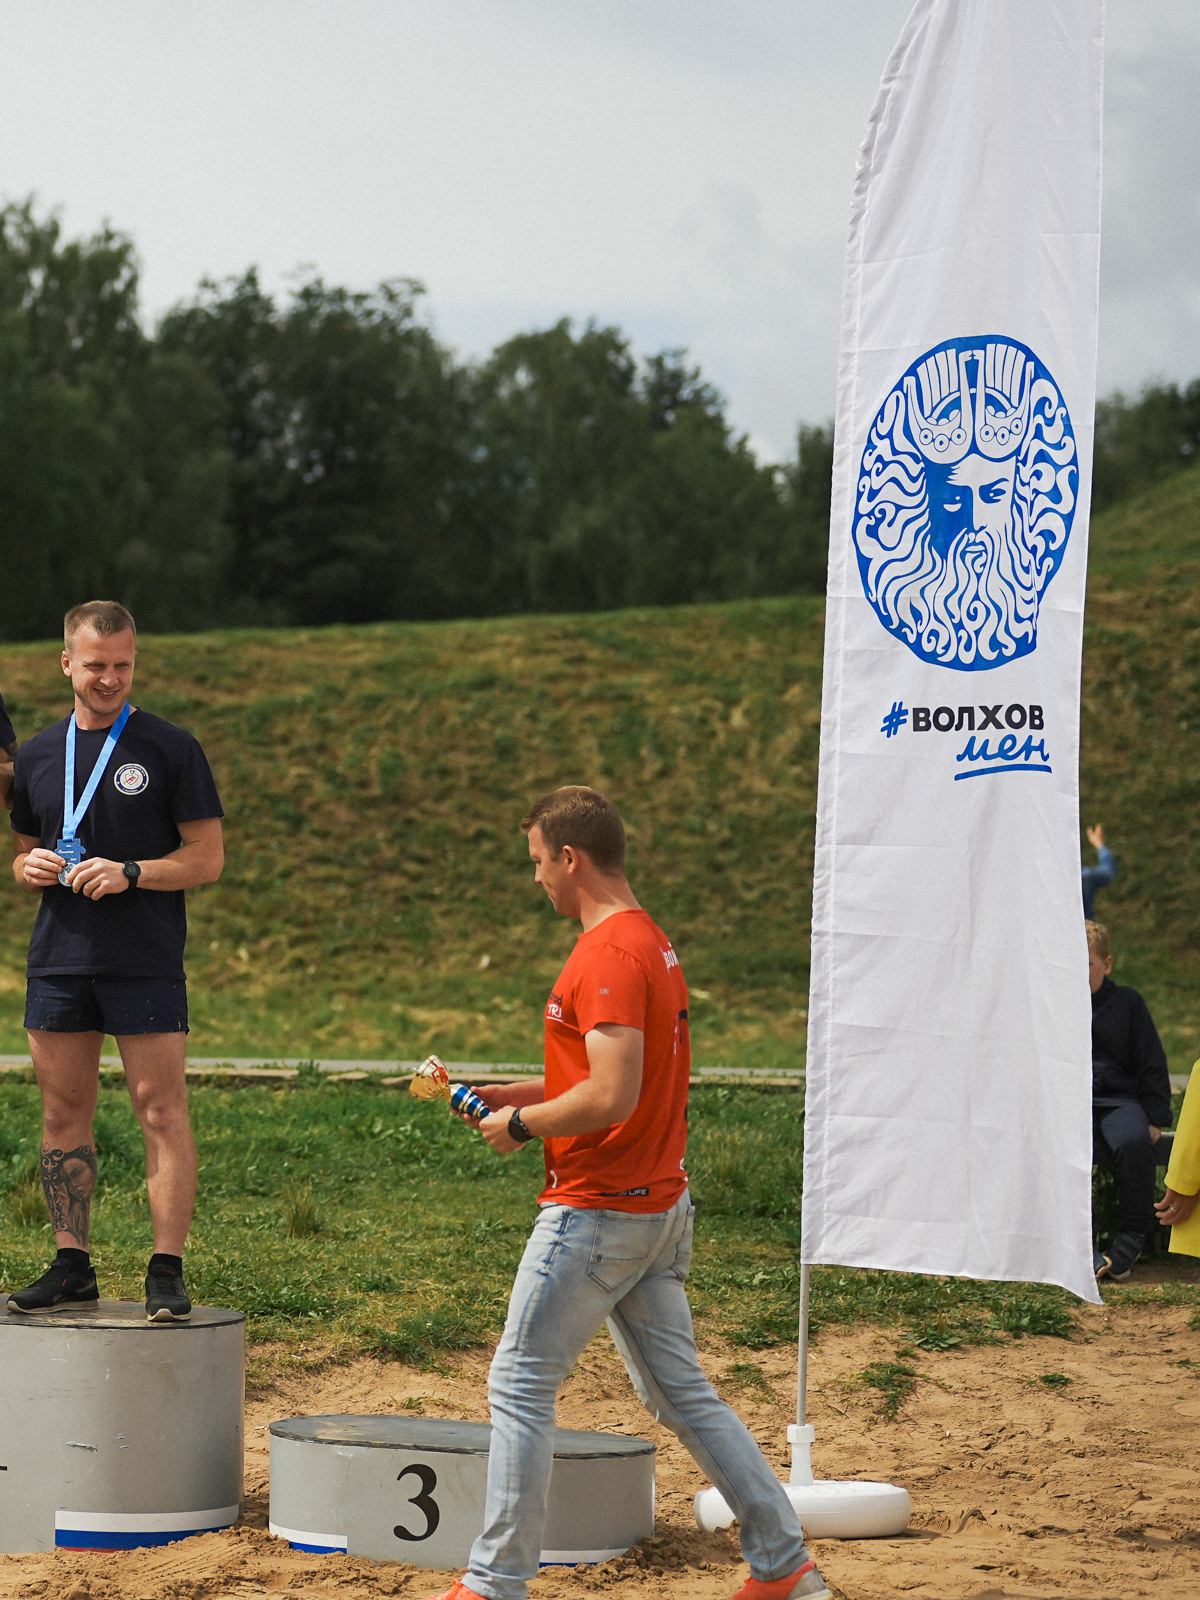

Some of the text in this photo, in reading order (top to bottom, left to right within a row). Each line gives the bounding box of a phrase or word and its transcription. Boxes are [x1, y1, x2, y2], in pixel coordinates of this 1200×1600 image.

[880, 701, 1045, 738] #ВОЛХОВ
[956, 734, 1050, 762] мен
[394, 1463, 440, 1541] 3
